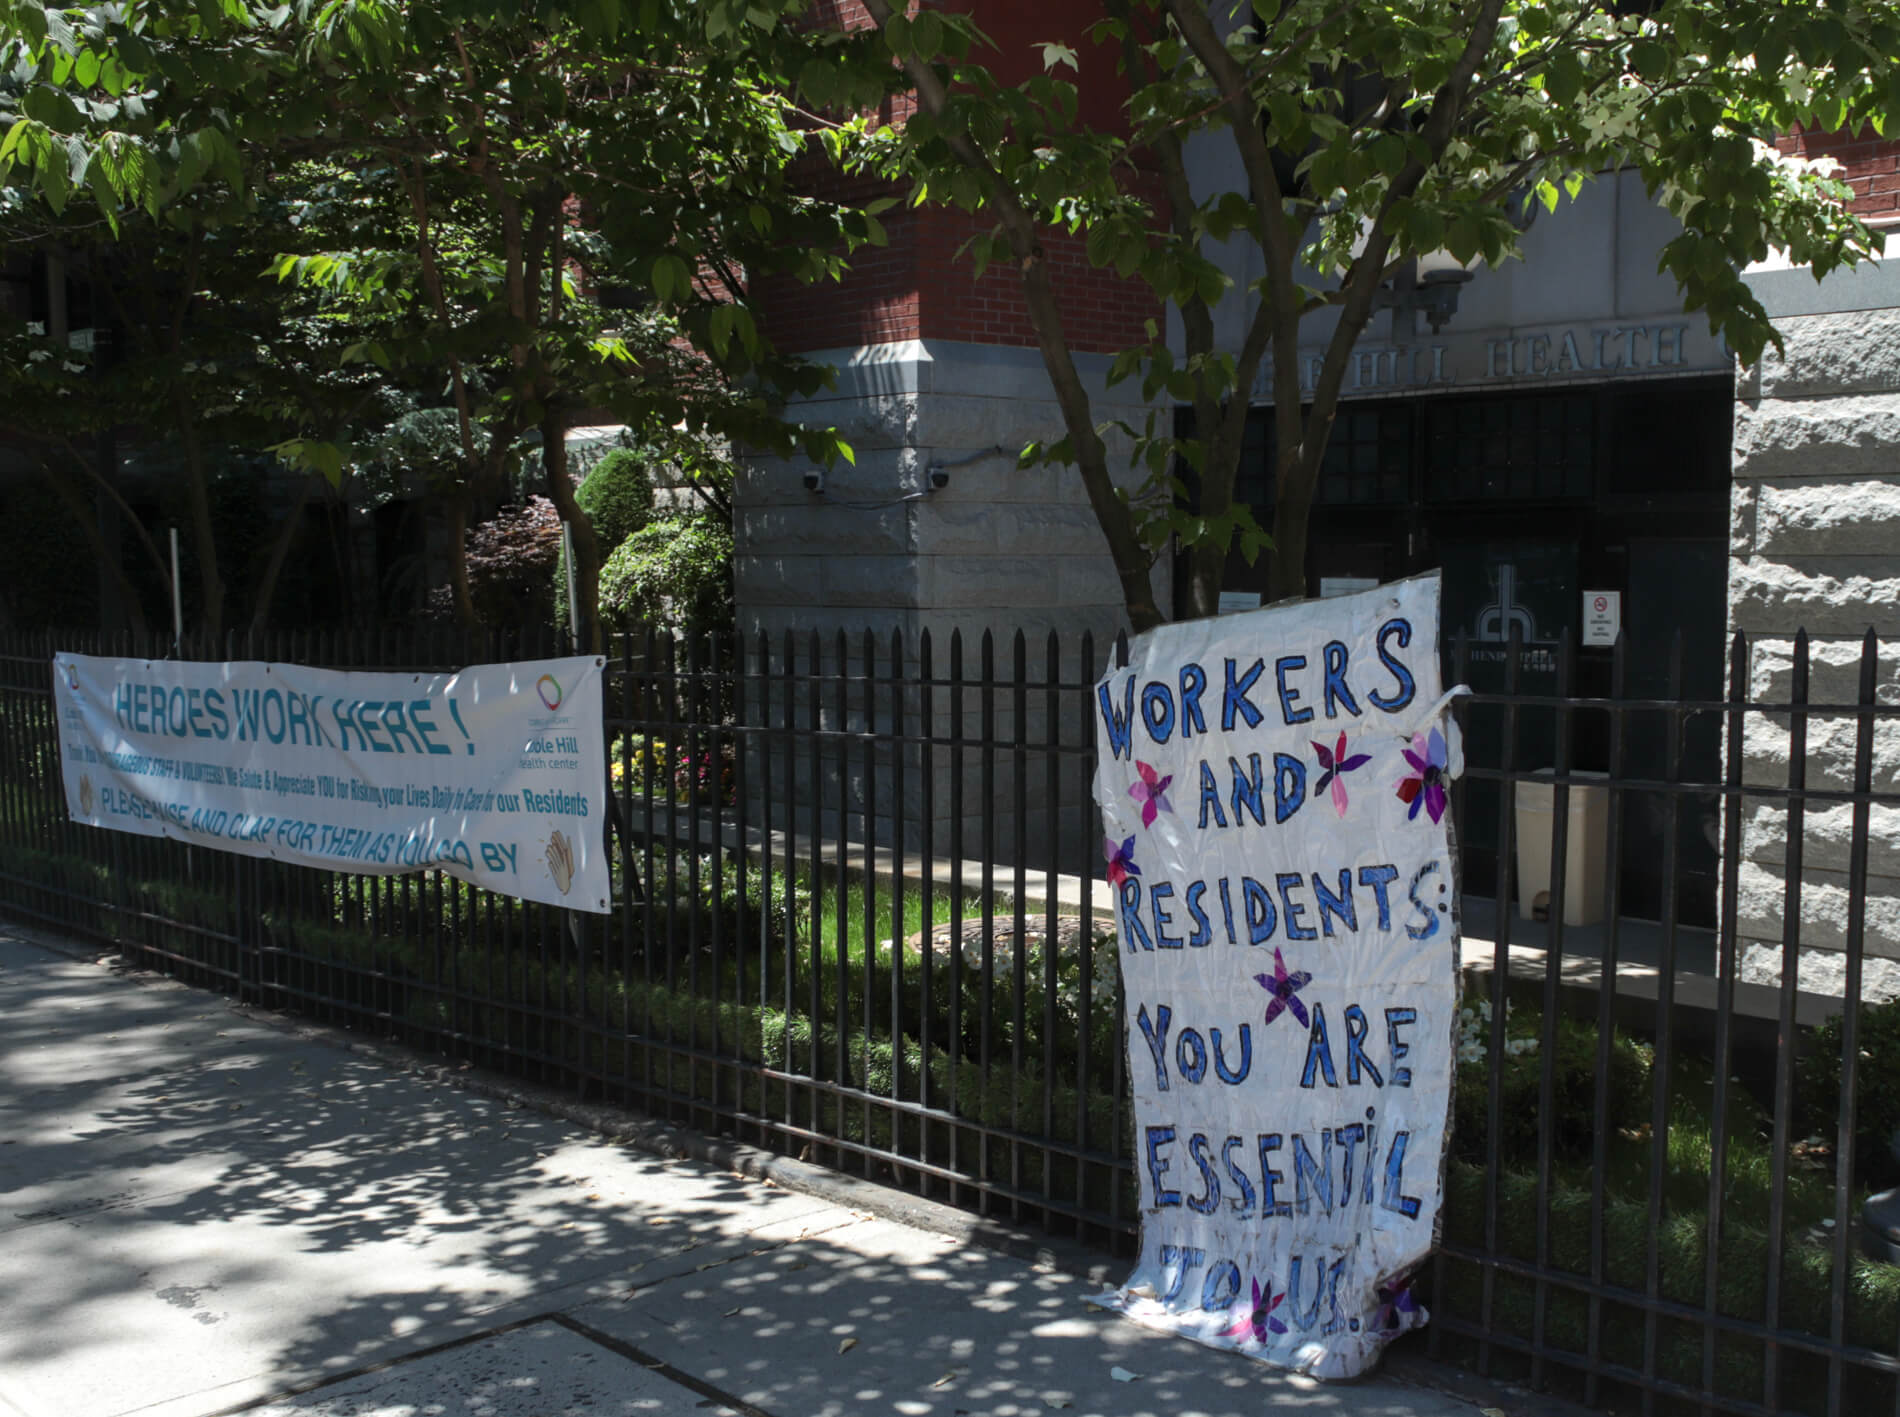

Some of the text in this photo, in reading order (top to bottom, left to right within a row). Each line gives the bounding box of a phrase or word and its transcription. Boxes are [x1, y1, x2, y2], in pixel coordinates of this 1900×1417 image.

[1486, 320, 1690, 380] HEALTH
[116, 682, 230, 741] HEROES
[232, 688, 337, 748] WORK
[1098, 618, 1416, 761] WORKERS
[517, 757, 578, 770] ealth center
[556, 736, 578, 753] Hill
[264, 770, 271, 791] &
[273, 770, 315, 797] Appreciate
[317, 775, 335, 798] YOU
[337, 777, 349, 799] for
[351, 778, 382, 809] Risking
[382, 786, 404, 809] your
[406, 784, 430, 808] Lives
[432, 785, 455, 813] Daily
[497, 792, 521, 813] our
[522, 788, 589, 817] Residents
[1198, 752, 1307, 829] AND
[102, 787, 152, 819] PLEASE
[191, 807, 227, 837] AND
[228, 812, 276, 843] CLAP
[277, 818, 317, 851] FOR
[319, 824, 371, 859] THEM
[365, 831, 395, 864] AS
[395, 832, 433, 867] YOU
[435, 838, 474, 871] GO
[480, 842, 517, 874] BY
[1136, 1002, 1417, 1092] YOU ARE
[1159, 1244, 1242, 1313] TO
